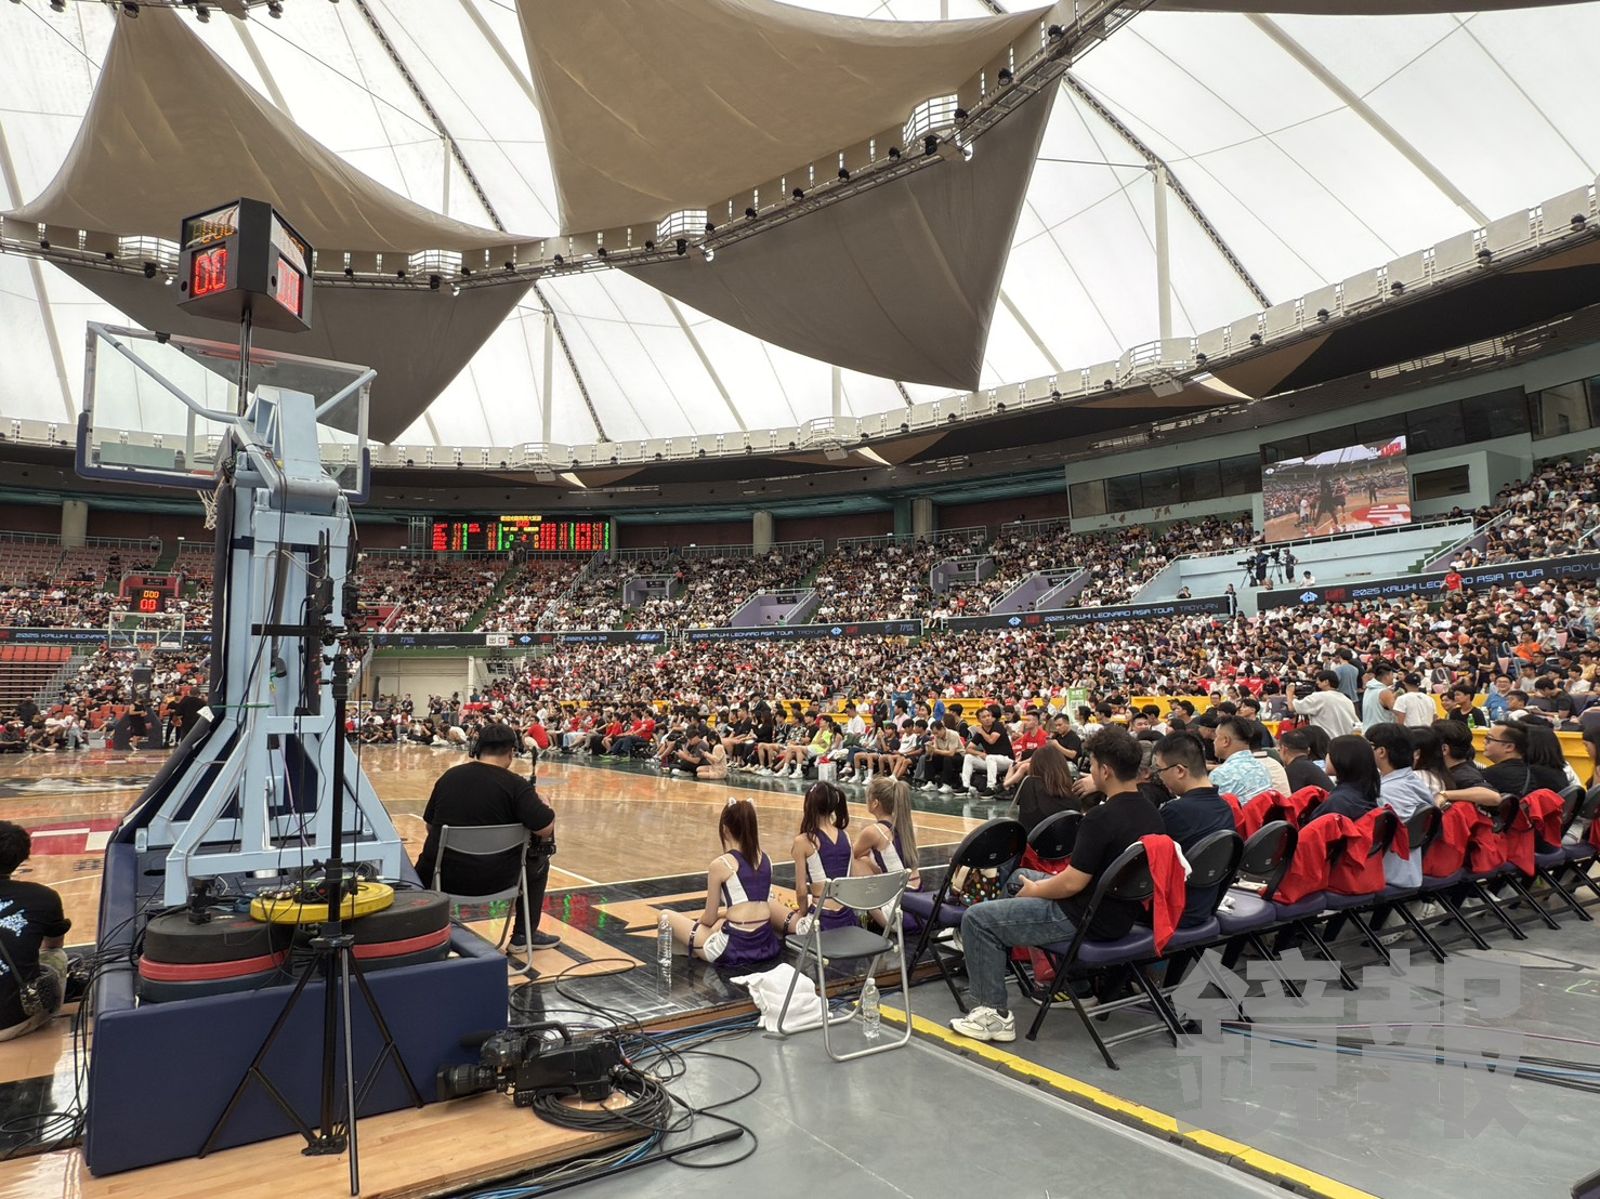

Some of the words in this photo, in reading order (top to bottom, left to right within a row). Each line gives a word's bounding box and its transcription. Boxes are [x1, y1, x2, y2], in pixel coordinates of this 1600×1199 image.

[1476, 573, 1505, 583] ASIA
[1508, 569, 1544, 580] TOUR
[1152, 606, 1174, 614] TOUR
